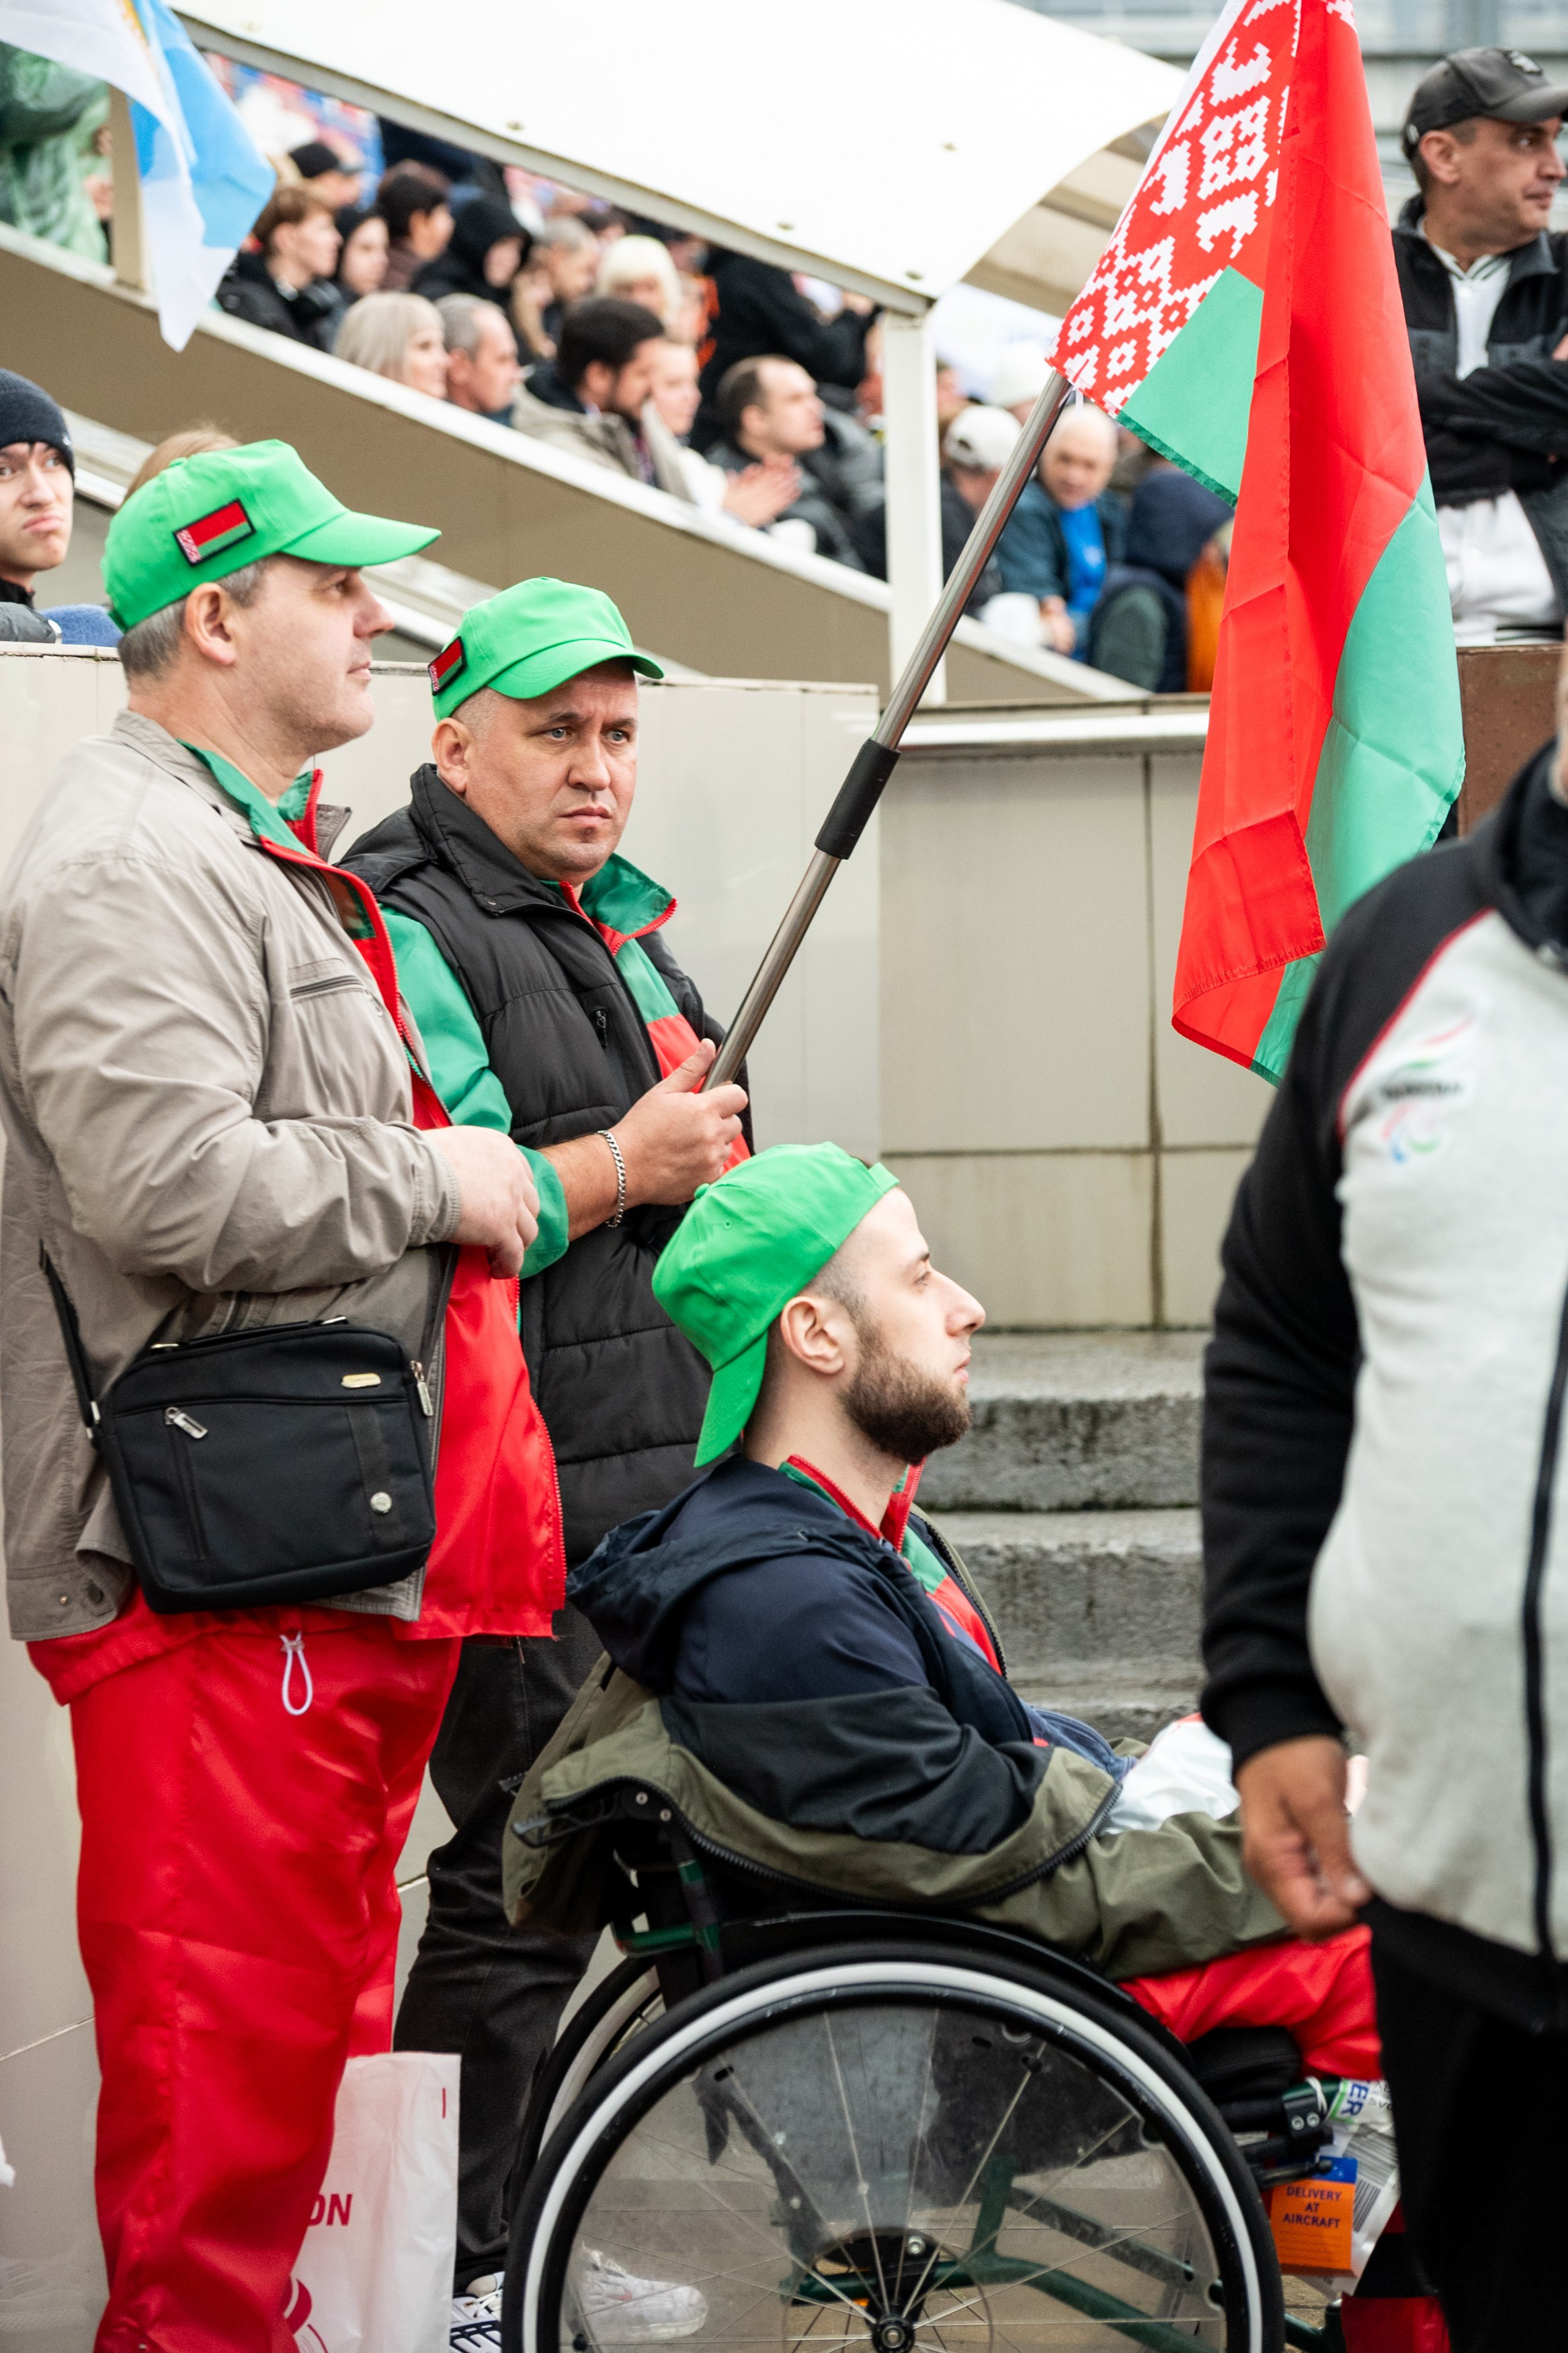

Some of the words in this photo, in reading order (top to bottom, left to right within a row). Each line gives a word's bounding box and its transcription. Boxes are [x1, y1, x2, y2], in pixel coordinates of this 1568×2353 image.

[1342, 2083, 1369, 2116] ER
[1286, 2186, 1342, 2201] DELIVERY
[1305, 2202, 1320, 2212] AT
[1283, 2214, 1341, 2228] AIRCRAFT
